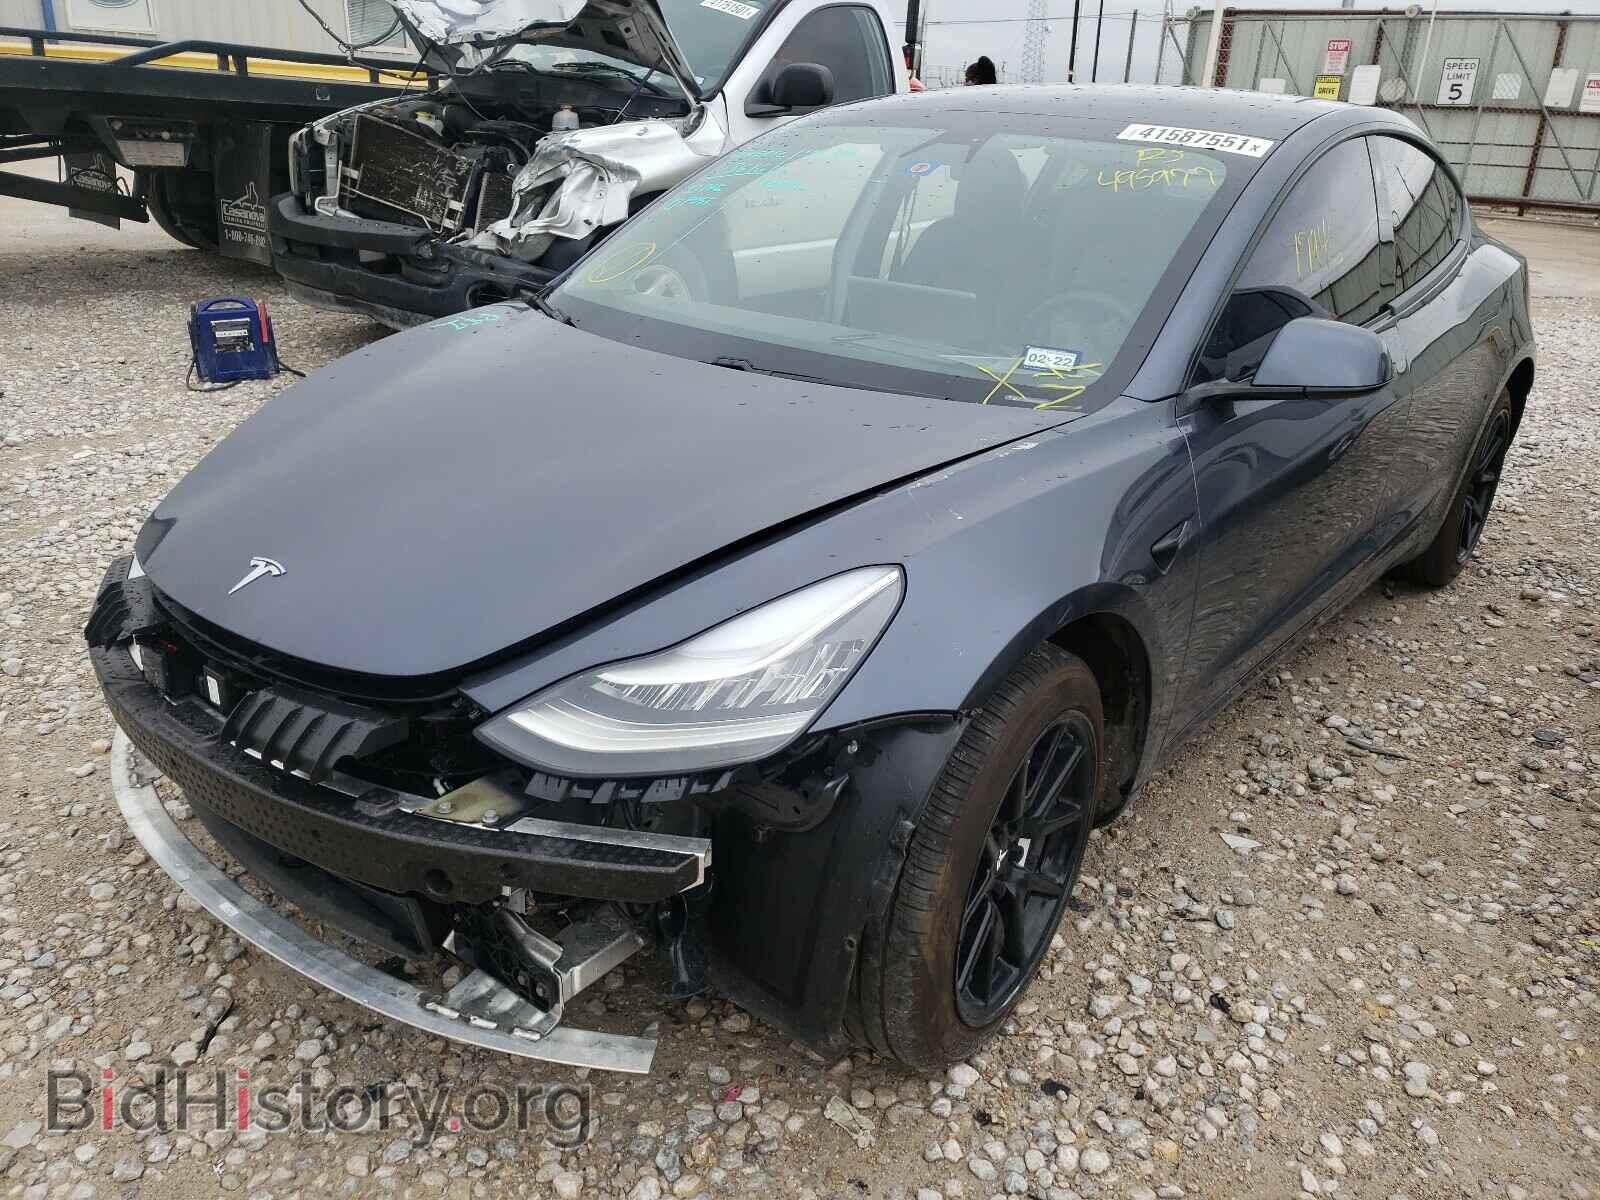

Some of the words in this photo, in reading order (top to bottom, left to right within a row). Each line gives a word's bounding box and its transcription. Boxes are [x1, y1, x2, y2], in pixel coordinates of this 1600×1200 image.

[1329, 41, 1349, 50] STOP
[1446, 62, 1477, 70] SPEED
[1318, 87, 1337, 95] DRIVE
[1448, 84, 1463, 100] 5
